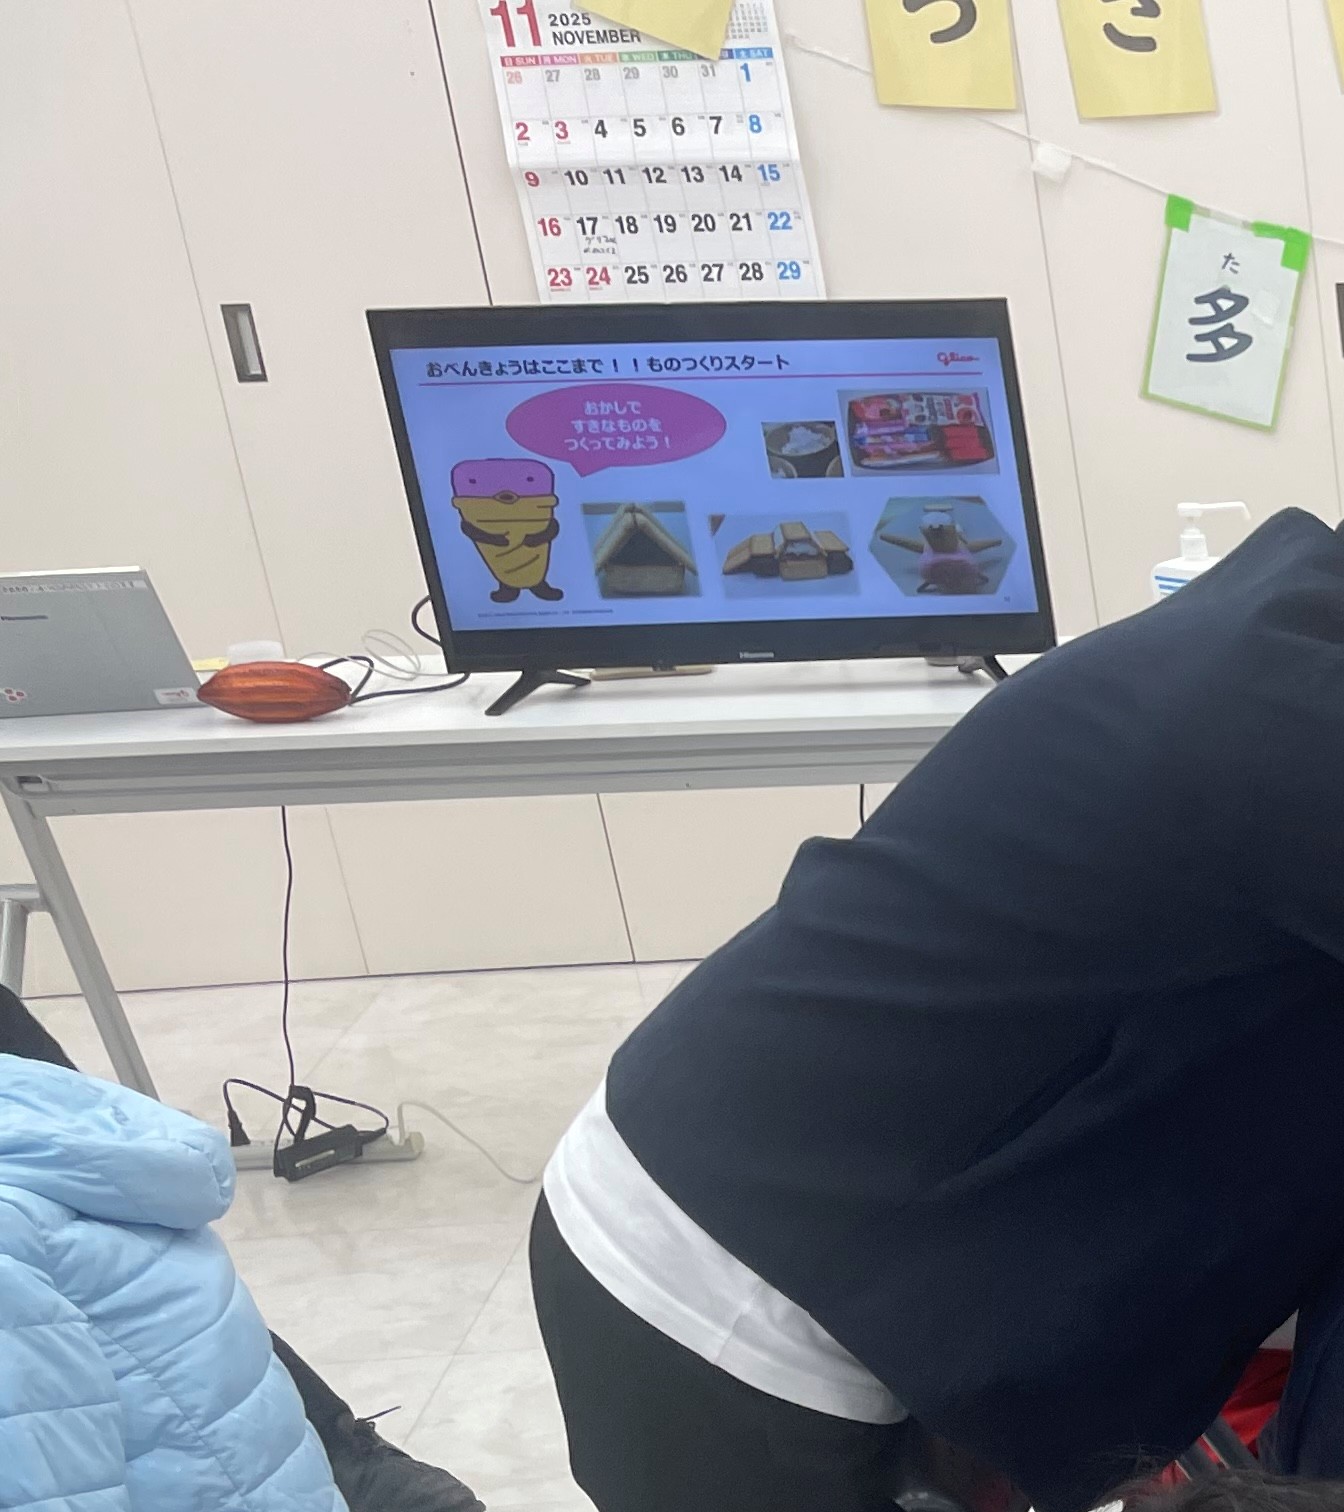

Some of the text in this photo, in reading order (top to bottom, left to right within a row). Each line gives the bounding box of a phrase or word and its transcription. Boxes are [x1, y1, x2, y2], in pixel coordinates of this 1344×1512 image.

[490, 0, 542, 47] 11
[548, 12, 592, 27] 2025
[552, 29, 641, 46] NOVEMBER
[515, 55, 536, 65] SUN
[554, 54, 577, 64] MON
[595, 53, 615, 62] TUE
[633, 52, 655, 61] WED
[750, 48, 769, 58] SAT
[506, 63, 751, 84] 26 27 28 29 30 31 1
[515, 114, 762, 141] 2 3 4 5 6 7 8
[524, 163, 781, 187] 9 10 11 12 13 14 15
[537, 211, 793, 237] 16 17 18 19 20 21 22
[547, 260, 801, 287] 23 24 25 26 27 28 29
[1221, 252, 1241, 275] た
[1186, 284, 1253, 363] 多
